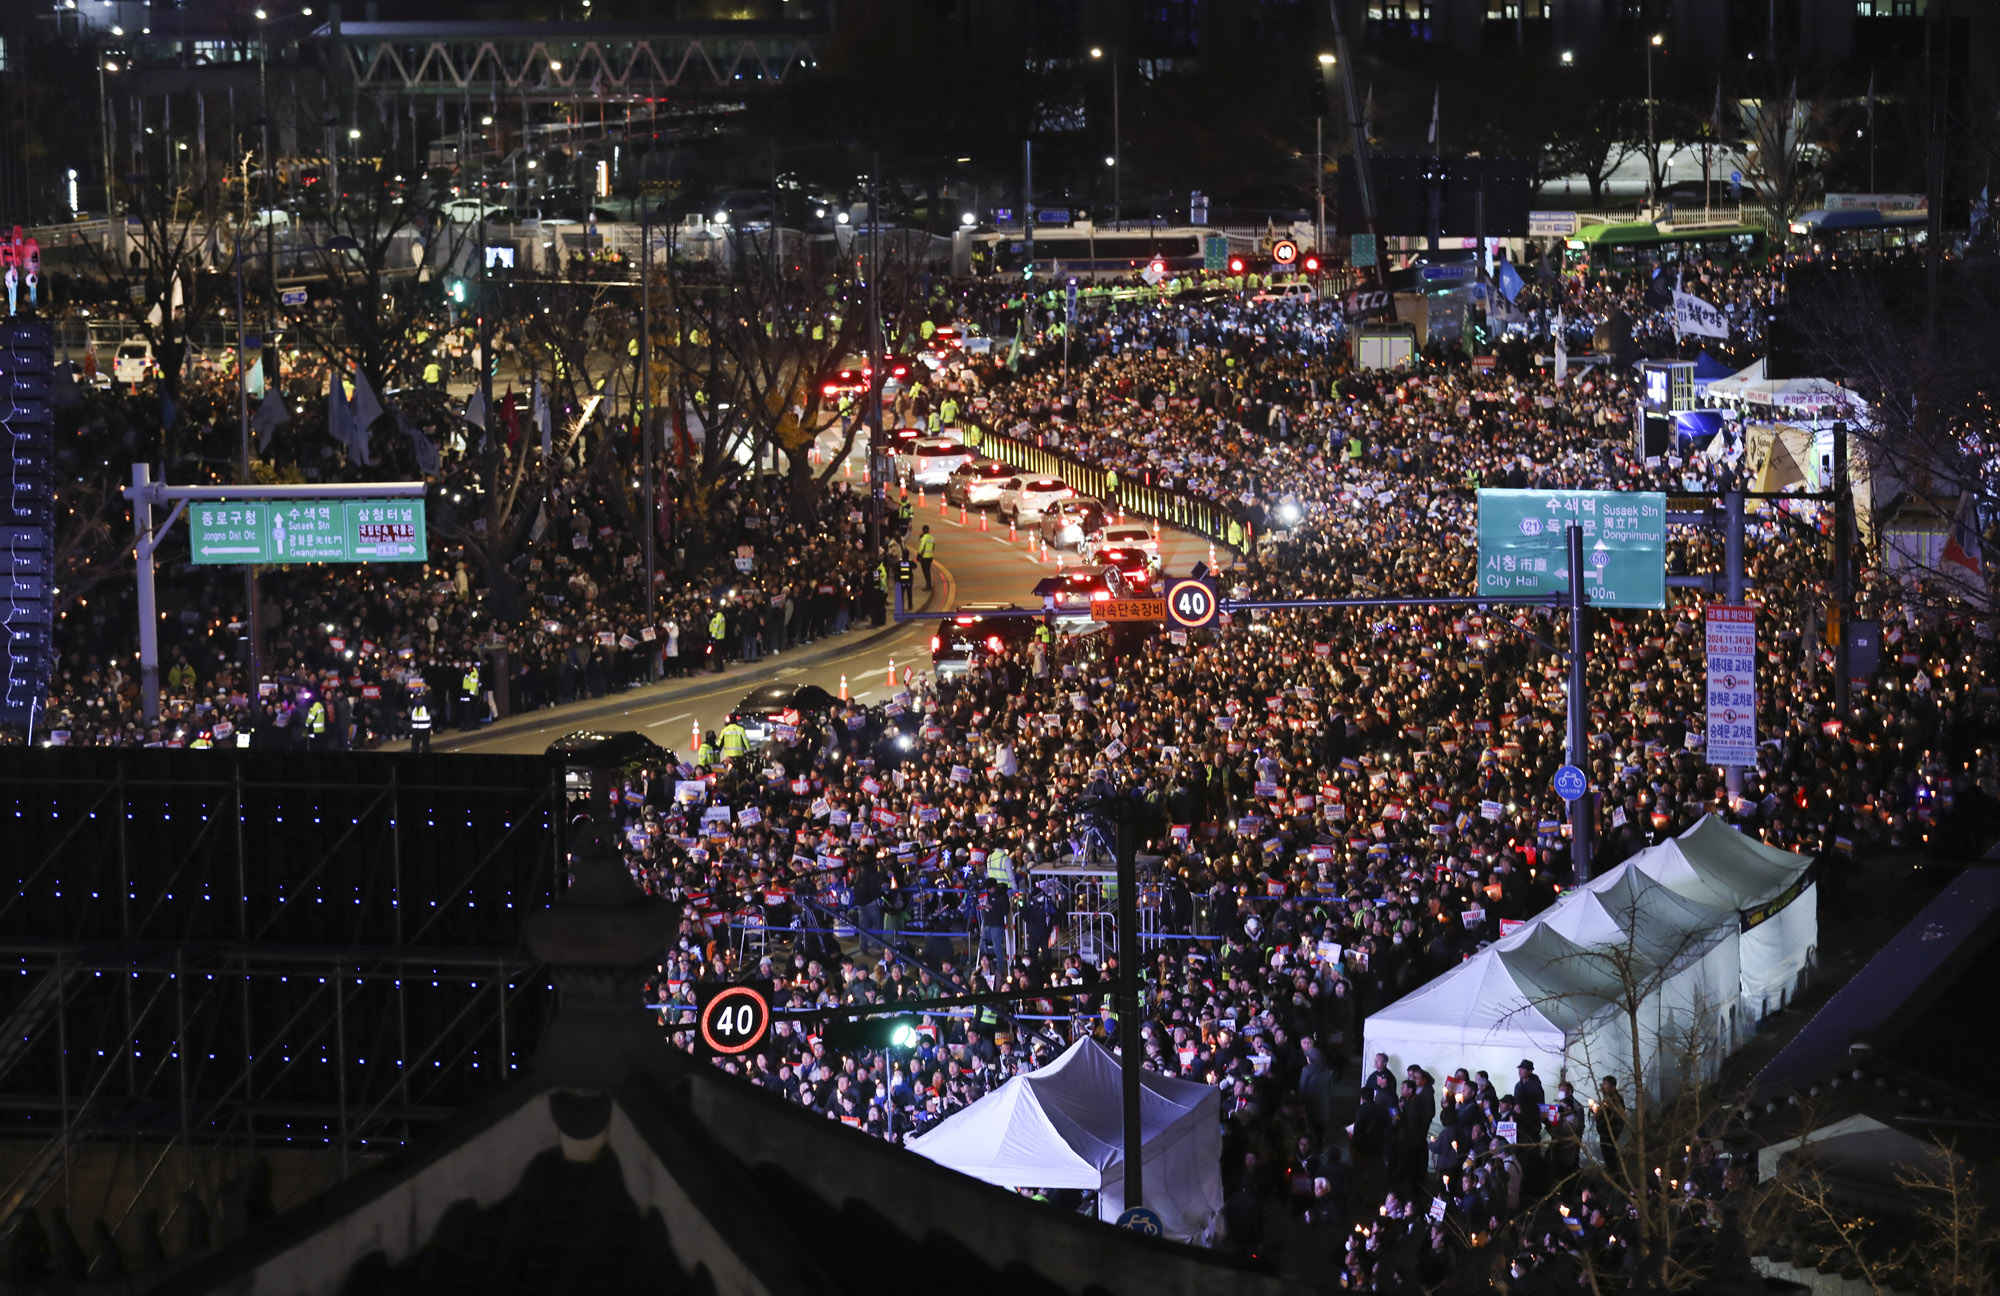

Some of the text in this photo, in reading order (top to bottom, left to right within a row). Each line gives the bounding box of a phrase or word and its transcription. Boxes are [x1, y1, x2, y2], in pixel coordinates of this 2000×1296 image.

[1278, 246, 1293, 259] 40
[1546, 497, 1596, 515] 수색역
[1603, 504, 1658, 517] Susaek Stn
[202, 510, 256, 526] 종로구청
[289, 507, 330, 520] 수색역
[358, 508, 412, 521] 삼청터널
[288, 521, 330, 531] Susaek Stn
[1525, 522, 1538, 532] 21
[203, 530, 256, 542] Jongno Dist Ofc
[289, 534, 313, 547] 광화문
[1603, 530, 1660, 542] Dongnimmun
[290, 548, 343, 557] Gwanghwamun
[1594, 554, 1606, 564] 50
[1486, 554, 1516, 571] 시청
[1486, 575, 1538, 588] City Hall
[1095, 602, 1164, 617] 과속단속장비
[1178, 593, 1205, 615] 40
[1708, 608, 1752, 621] 교통통제안내
[1708, 635, 1753, 645] 2024.11.24(일)
[1709, 658, 1752, 673] 세종대로 교차로
[1710, 692, 1752, 707] 광화문 교차로
[1710, 724, 1752, 739] 숭례문 교차로
[717, 1004, 753, 1036] 40
